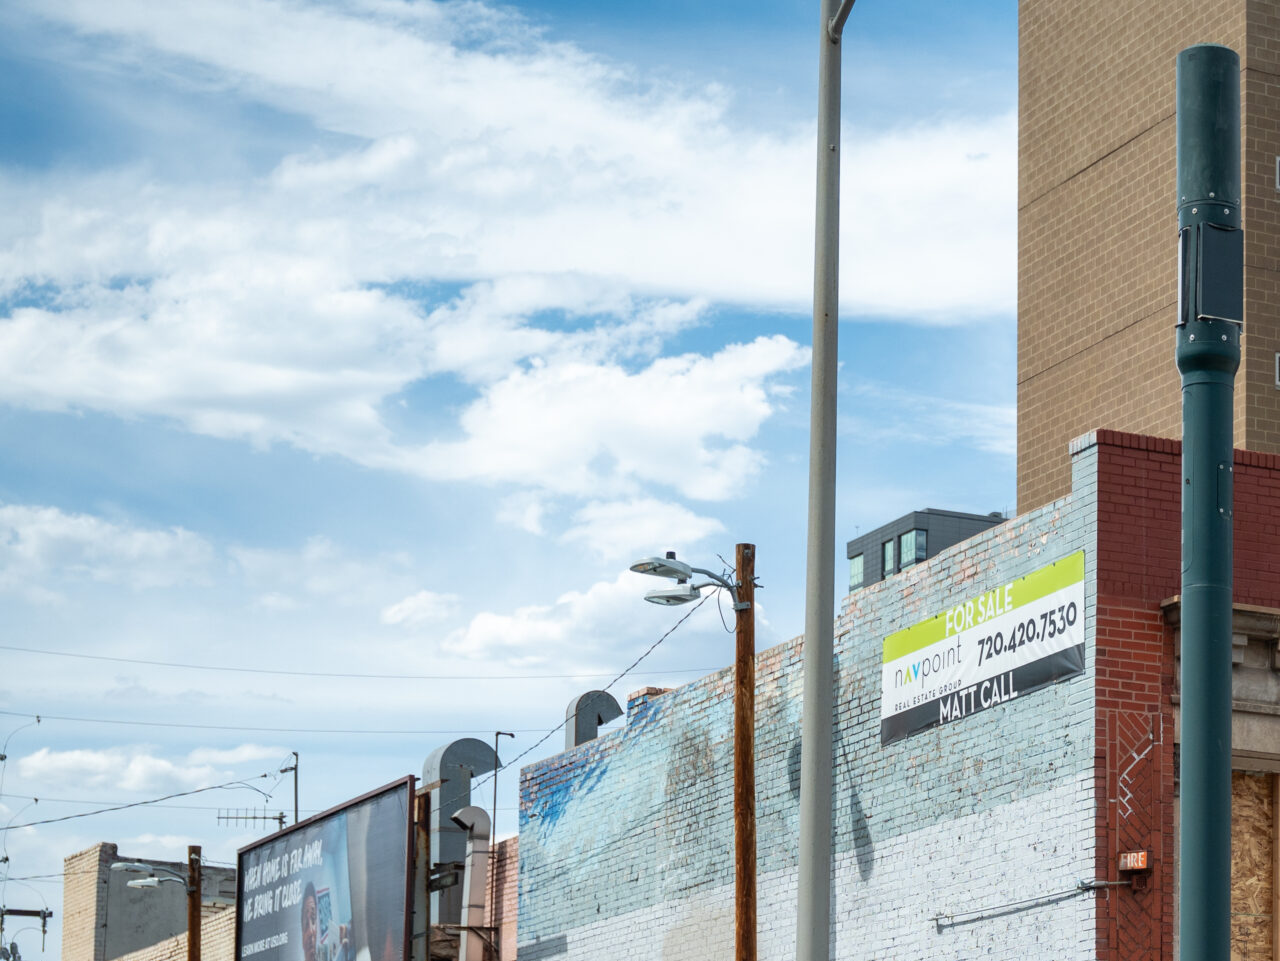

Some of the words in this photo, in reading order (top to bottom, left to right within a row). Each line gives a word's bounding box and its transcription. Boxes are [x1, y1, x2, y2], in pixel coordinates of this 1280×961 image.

[946, 603, 974, 637] FOR
[977, 583, 1014, 621] SALE
[977, 601, 1078, 667] 720.420.7530
[894, 700, 910, 712] REAL
[913, 689, 936, 705] ESTATE
[939, 679, 962, 695] GROUP
[939, 684, 977, 726] MATT
[981, 671, 1018, 709] CALL
[244, 863, 262, 893] WHEN
[262, 856, 280, 886] HOME
[281, 853, 288, 878] IS
[290, 848, 303, 875] FAR
[1120, 852, 1145, 868] FIRE
[253, 890, 273, 919] BRING
[274, 886, 282, 912] IT
